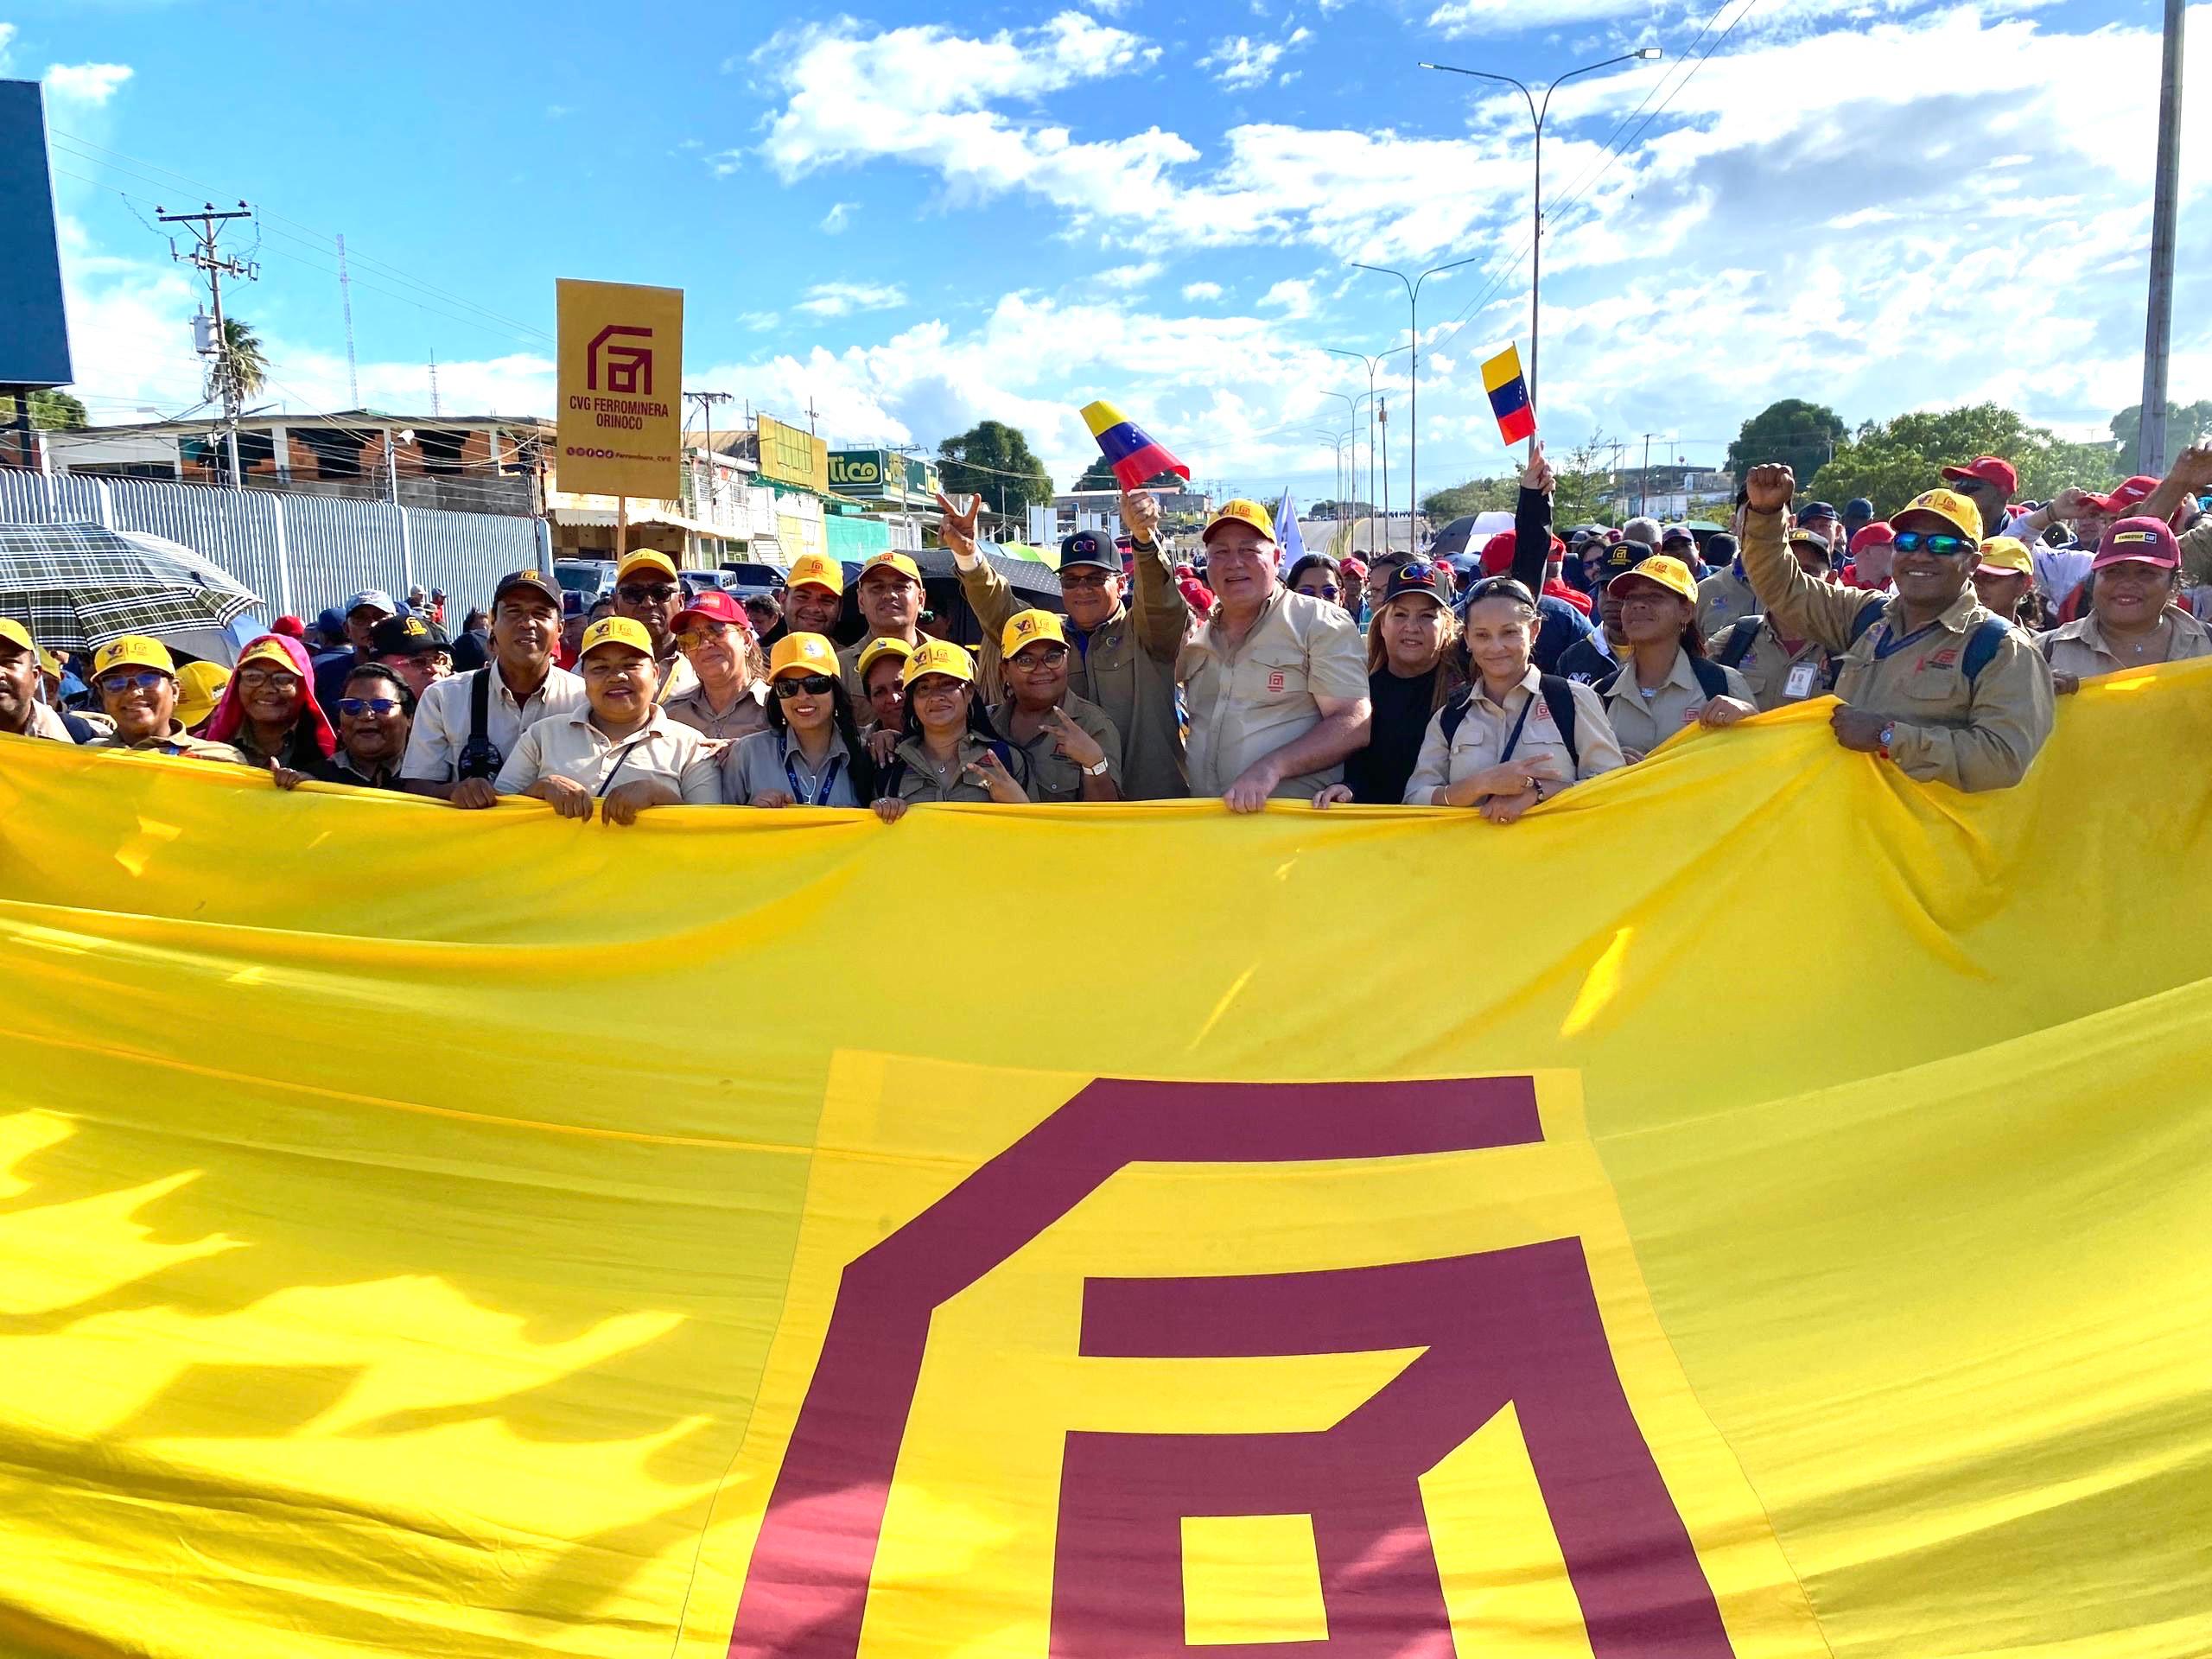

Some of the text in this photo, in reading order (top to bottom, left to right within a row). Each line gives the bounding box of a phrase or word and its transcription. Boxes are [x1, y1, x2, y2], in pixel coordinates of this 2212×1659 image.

[570, 396, 669, 417] CVG FERROMINERA
[596, 413, 643, 430] ORINOCO
